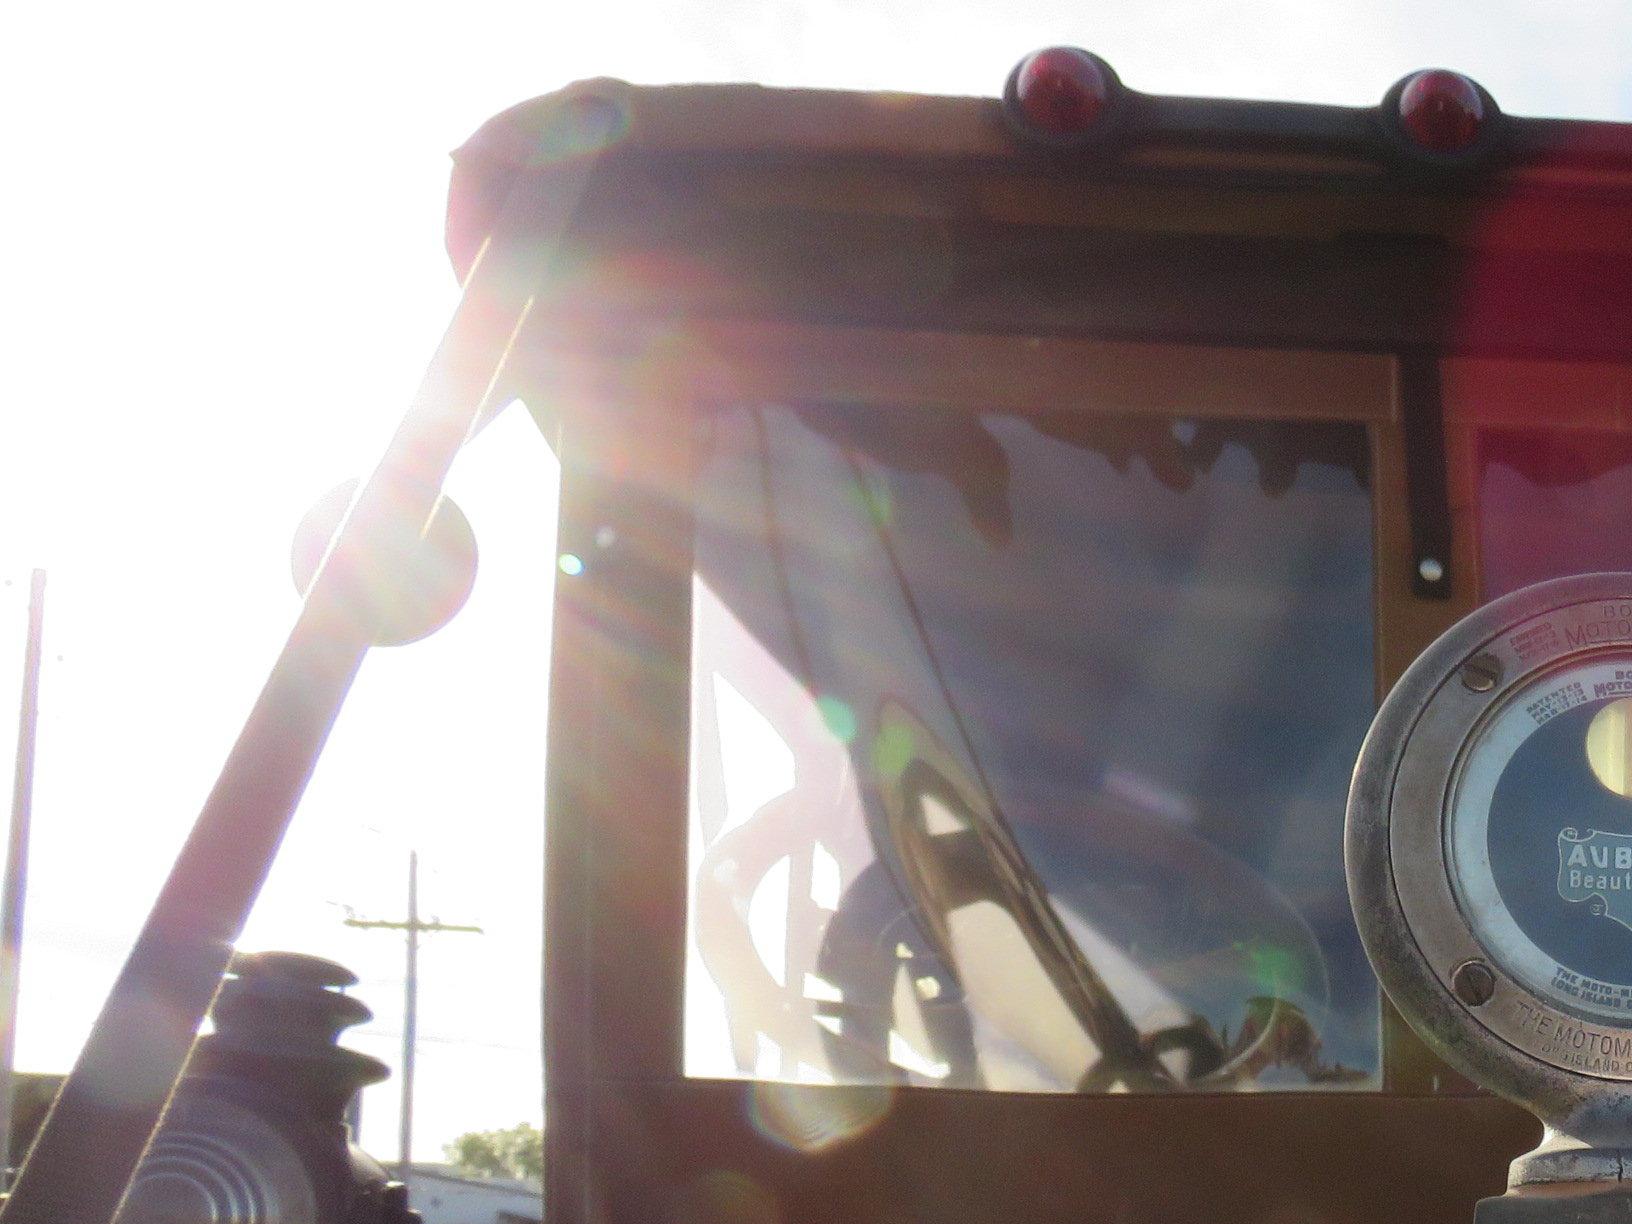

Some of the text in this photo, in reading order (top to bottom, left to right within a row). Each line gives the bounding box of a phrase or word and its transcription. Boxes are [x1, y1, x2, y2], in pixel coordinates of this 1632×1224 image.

[1555, 966, 1579, 984] THE
[1550, 976, 1579, 997] LONG
[1580, 991, 1621, 1009] ISLAND
